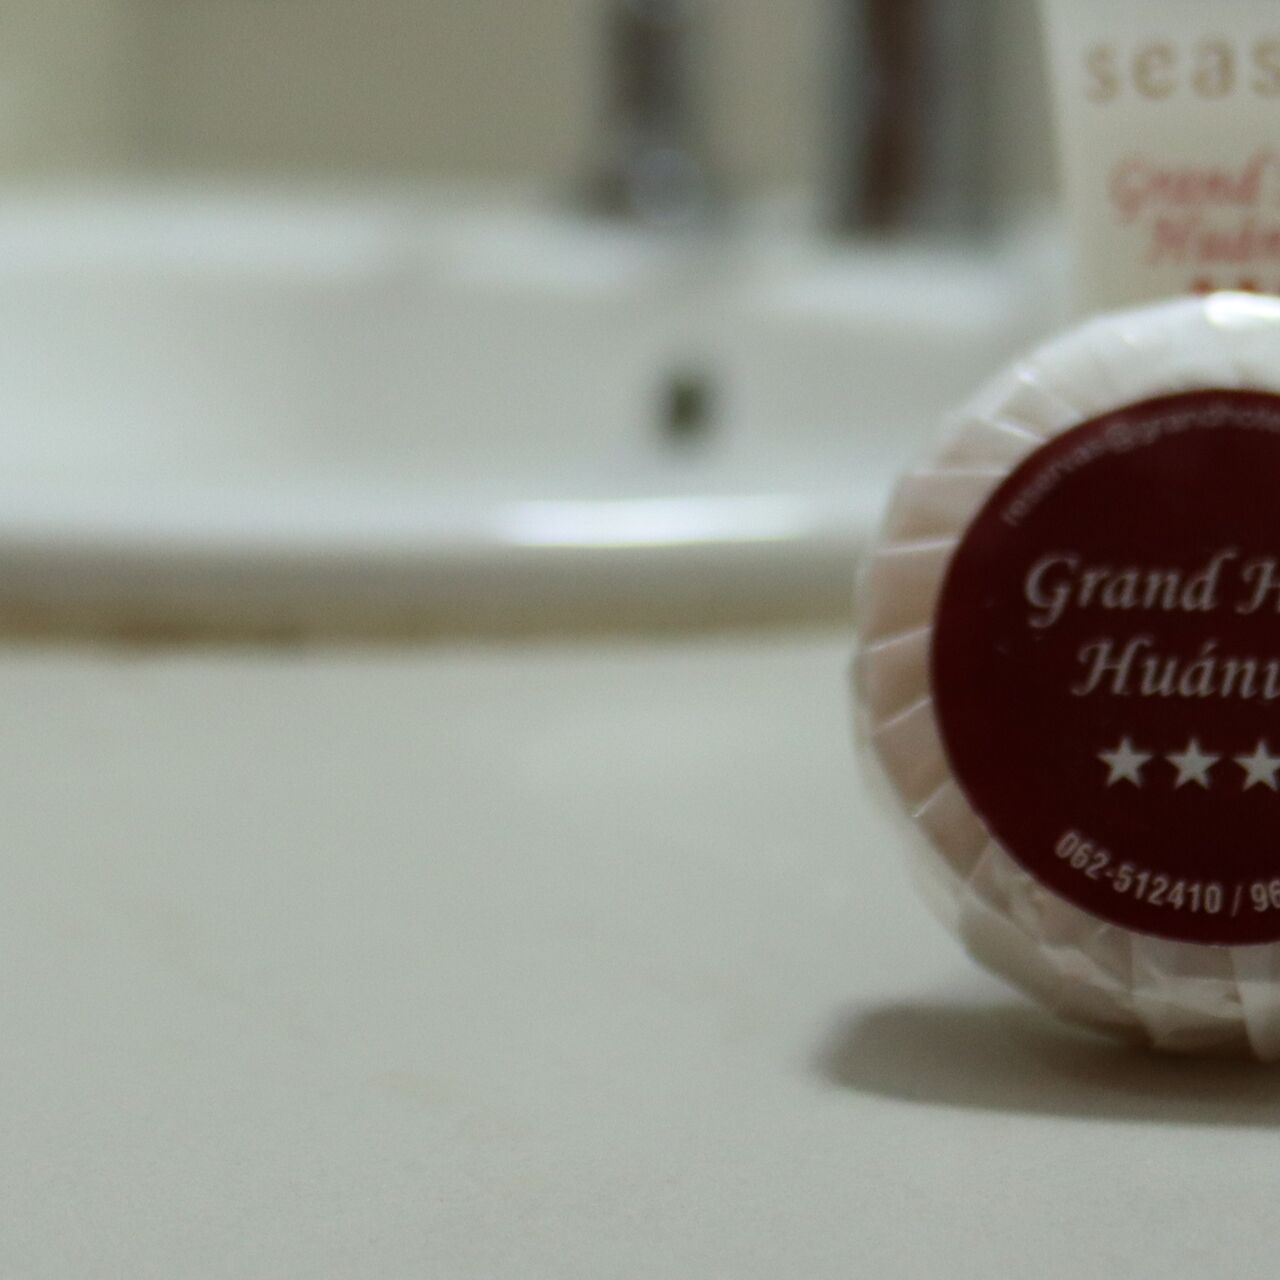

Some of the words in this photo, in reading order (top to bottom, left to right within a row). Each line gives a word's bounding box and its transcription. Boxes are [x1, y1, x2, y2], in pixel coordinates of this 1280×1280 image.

[1107, 152, 1270, 225] Grand
[1023, 547, 1237, 628] Grand
[1054, 830, 1222, 914] 062-512410
